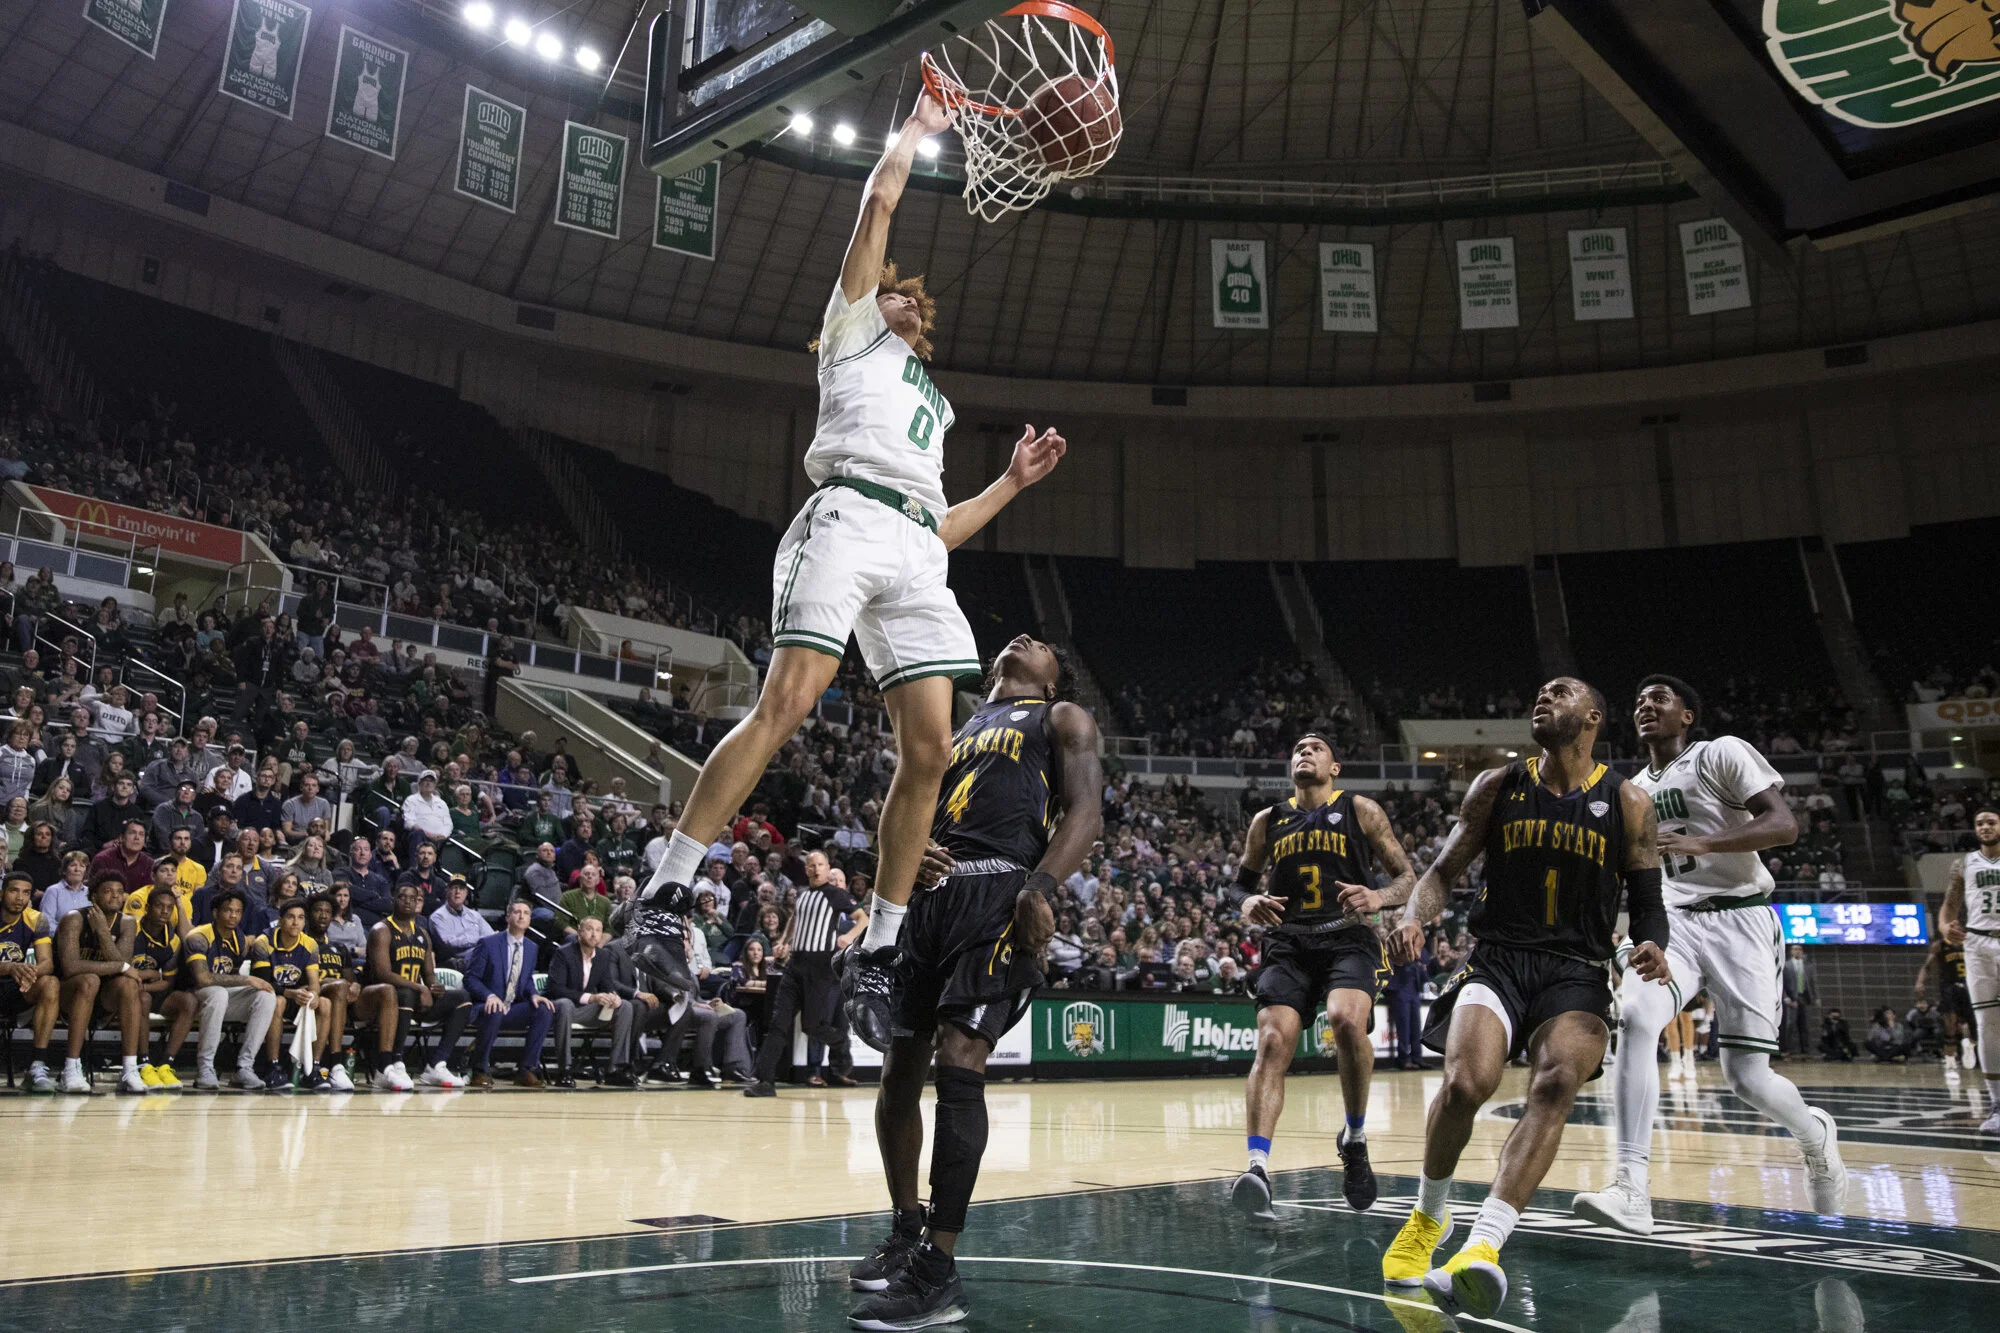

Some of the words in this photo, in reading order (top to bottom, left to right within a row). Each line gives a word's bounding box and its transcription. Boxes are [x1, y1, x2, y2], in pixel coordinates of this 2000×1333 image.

[352, 36, 396, 63] GARDNER
[229, 74, 289, 102] CHAMPION
[233, 68, 287, 94] NATIONAL
[338, 111, 388, 136] NATIONAL
[477, 102, 511, 134] OHIO
[335, 117, 390, 144] CHAMPION
[466, 138, 516, 165] TOURNAMENT
[483, 136, 501, 150] MAC
[578, 135, 614, 164] OHIO
[467, 147, 512, 172] CHAMPIONS
[566, 171, 618, 194] TOURNAMENT
[583, 168, 602, 181] MAC
[568, 181, 615, 201] CHAMPIONS
[679, 191, 697, 204] MAC
[662, 195, 713, 215] TOURNAMENT
[664, 204, 709, 223] CHAMPIONS
[1227, 243, 1251, 252] MAST
[1581, 234, 1615, 253] OHIO
[1694, 225, 1728, 246] OHIO
[1332, 249, 1362, 268] OHIO
[1471, 244, 1502, 263] OHIO
[1226, 272, 1253, 288] OHIO
[1585, 270, 1615, 281] WNIT
[1231, 288, 1251, 303] 40
[902, 355, 945, 428] OHIO
[908, 405, 934, 451] 0
[117, 515, 141, 531] i'm
[143, 521, 184, 540] lovin'
[184, 529, 197, 544] it
[102, 711, 127, 726] OHIO
[946, 769, 978, 823] 4
[1650, 788, 1690, 823] HIO
[1307, 829, 1348, 857] STATE
[1503, 819, 1548, 853] KENT
[1298, 864, 1323, 911] 3
[1543, 868, 1558, 926] 1
[1834, 904, 1873, 925] 1:13
[401, 963, 421, 983] 50
